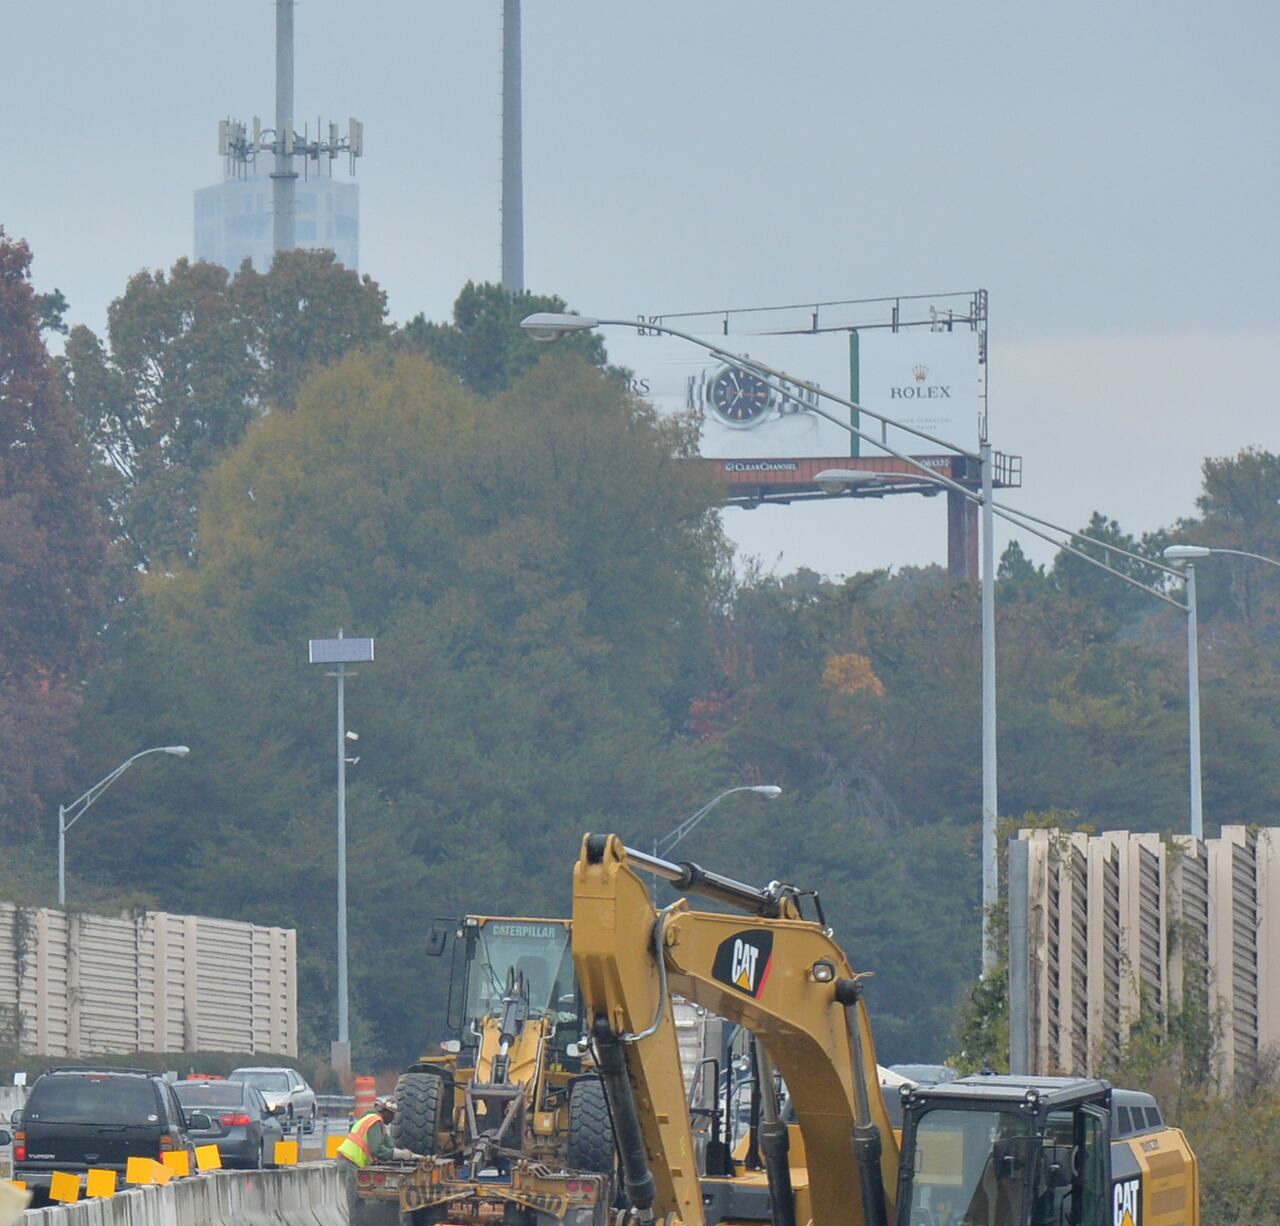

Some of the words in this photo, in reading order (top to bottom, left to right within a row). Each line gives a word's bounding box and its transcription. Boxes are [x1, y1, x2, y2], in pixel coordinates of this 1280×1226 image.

[890, 386, 951, 399] ROLEX
[492, 924, 555, 938] CATERPILLAR
[732, 938, 759, 991] CAT
